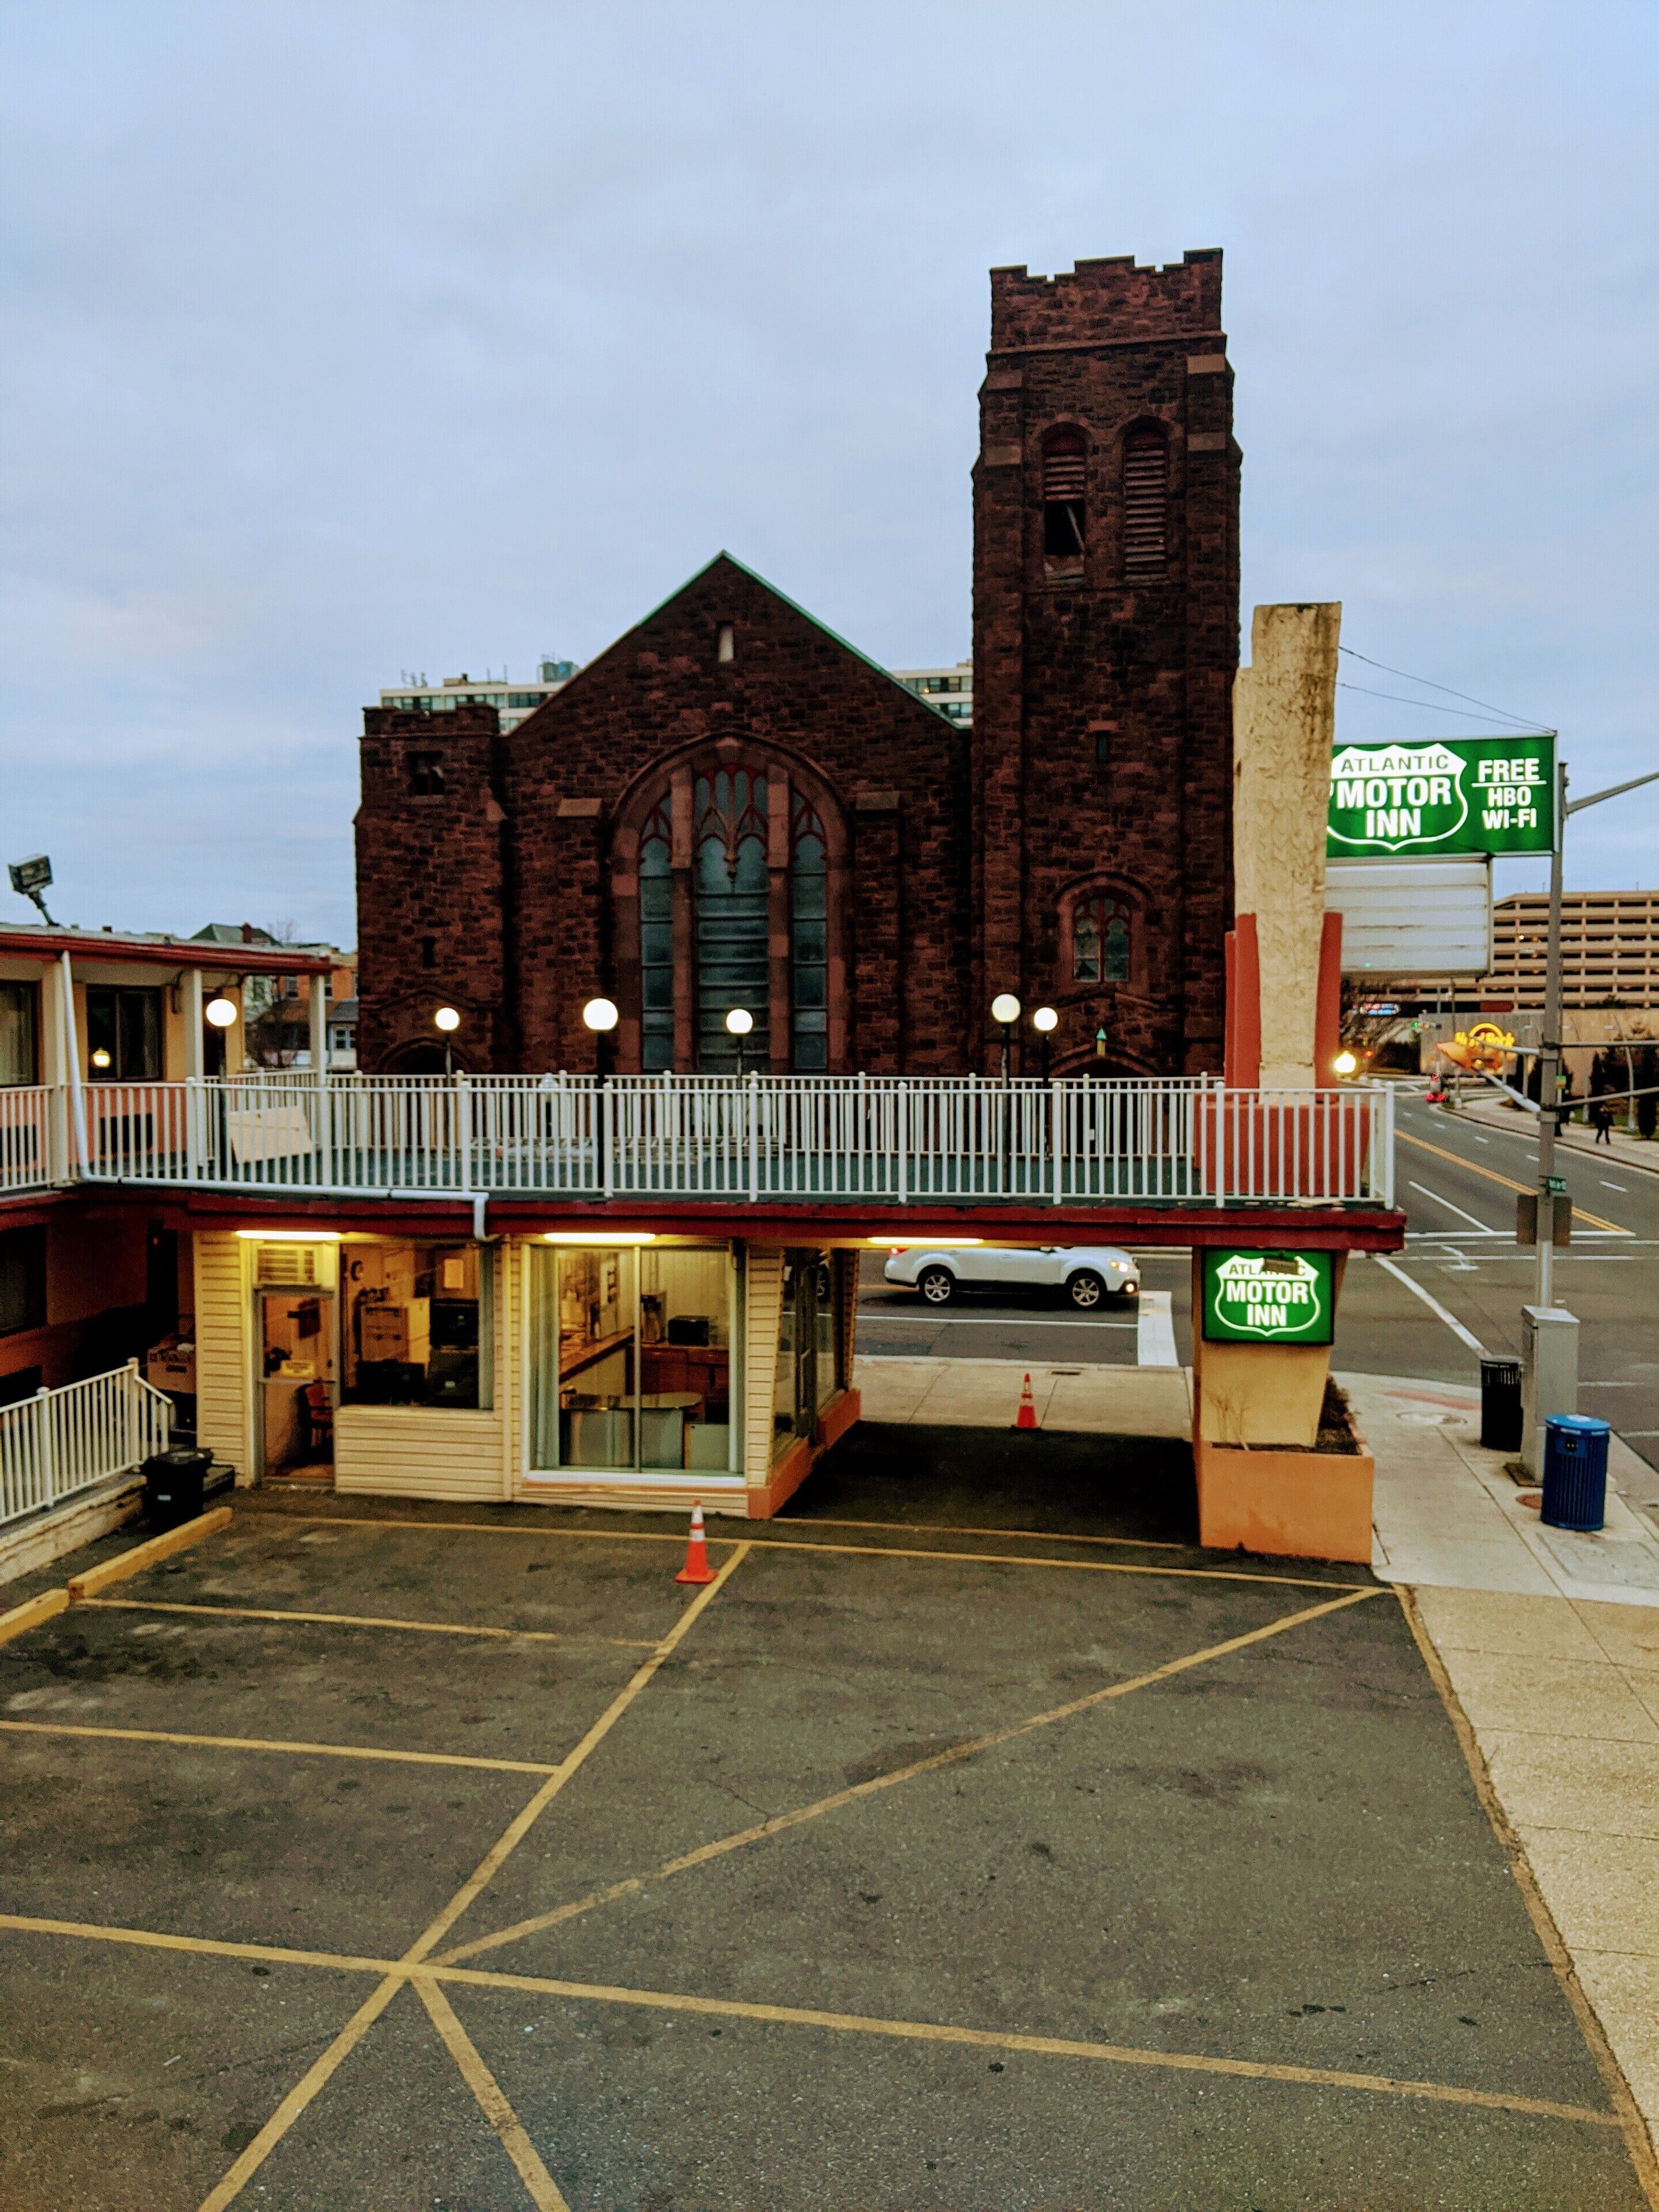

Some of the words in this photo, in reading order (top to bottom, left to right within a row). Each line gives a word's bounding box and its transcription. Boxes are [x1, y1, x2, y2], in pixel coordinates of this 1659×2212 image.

[1342, 755, 1449, 772] ATLANTIC
[1479, 758, 1540, 782] FREE
[1338, 778, 1451, 809] MOTOR
[1488, 786, 1532, 808] HBO
[1366, 809, 1421, 838] INN
[1482, 808, 1537, 830] WI-FI
[1230, 1264, 1305, 1276] ATLC
[1227, 1281, 1309, 1304] MOTOR
[1247, 1305, 1287, 1327] INN
